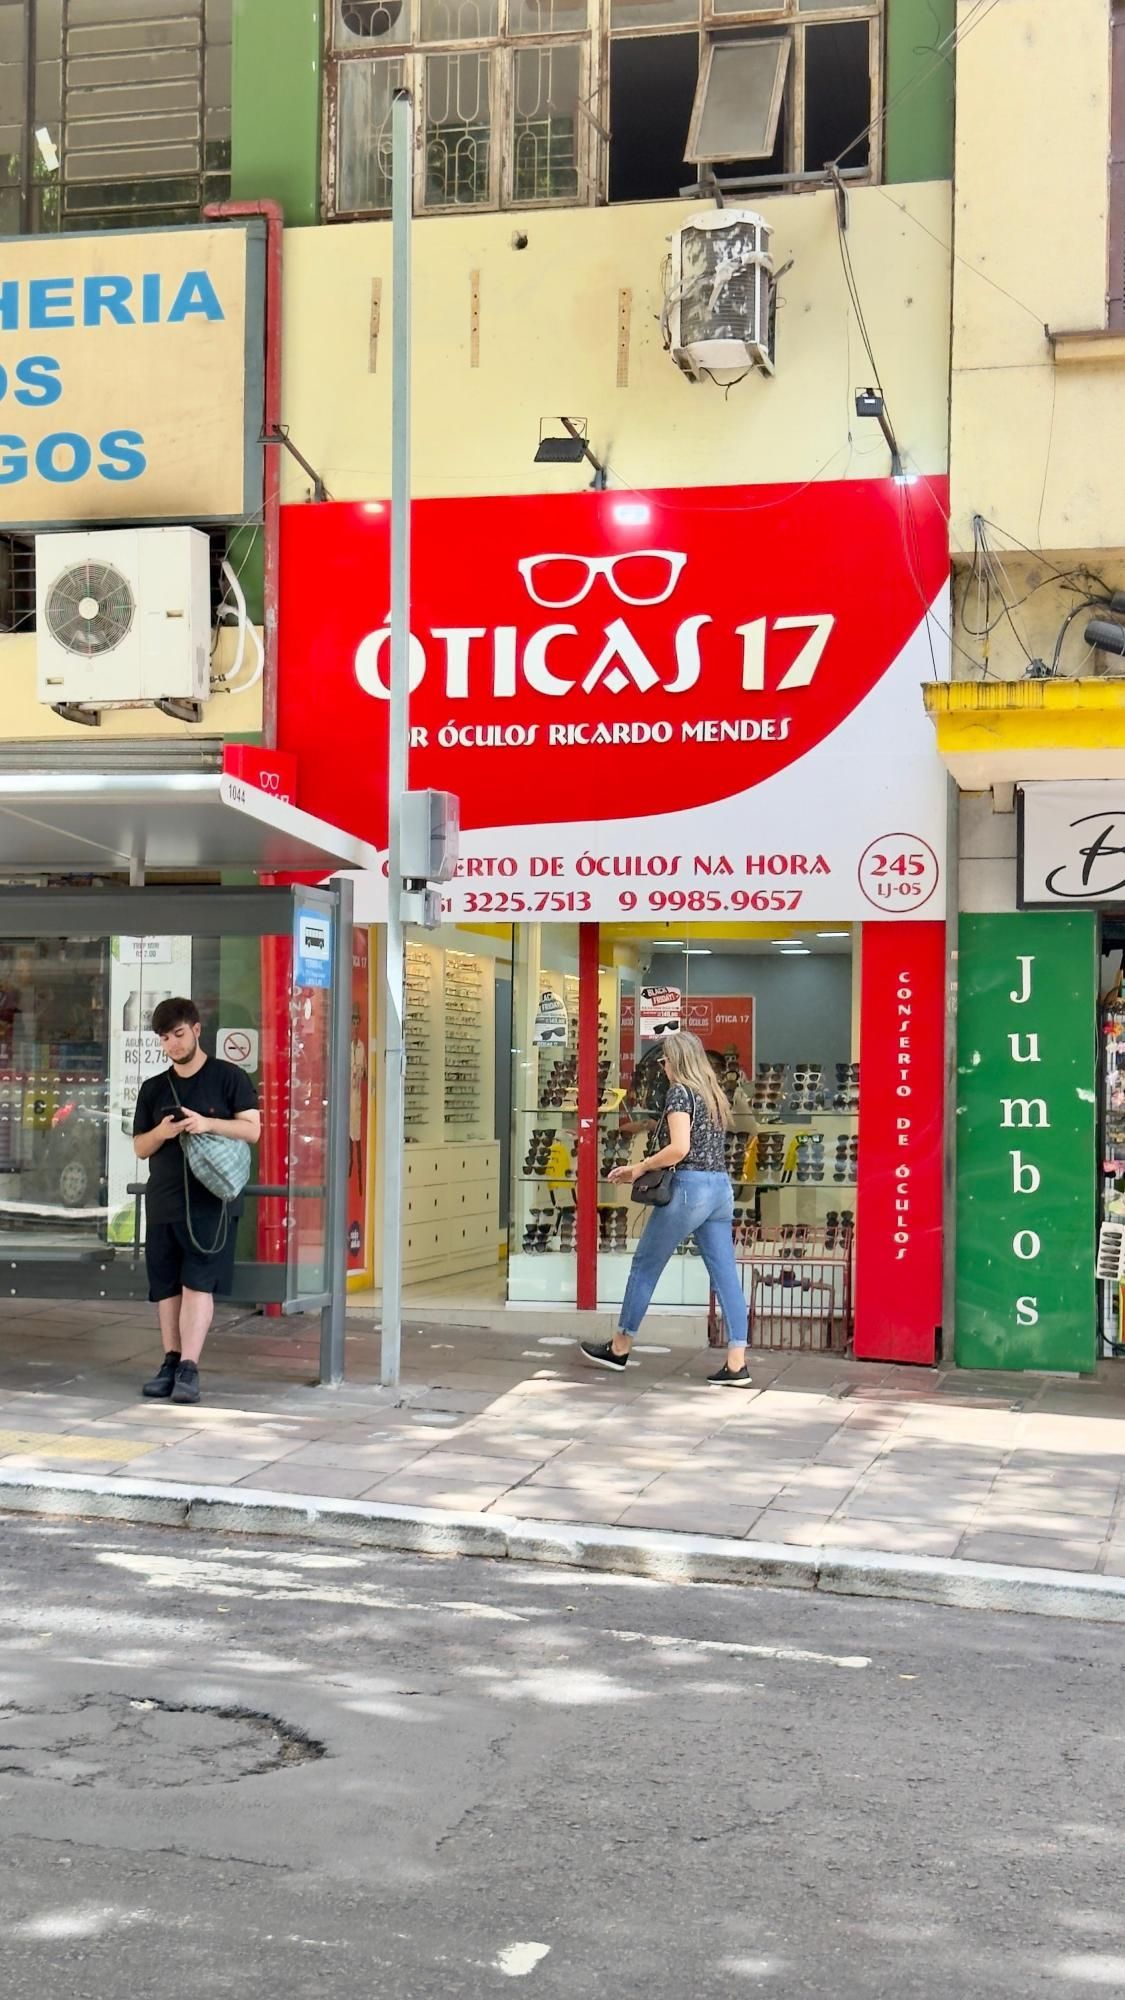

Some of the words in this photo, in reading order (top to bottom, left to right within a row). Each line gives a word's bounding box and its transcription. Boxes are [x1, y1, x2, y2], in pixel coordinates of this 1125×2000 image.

[354, 604, 712, 700] ÓTICAS
[735, 613, 835, 691] 17
[438, 719, 539, 748] ÓCULOS
[549, 721, 673, 746] RICARDO
[681, 717, 791, 743] MENDES
[228, 783, 246, 805] 1044
[530, 856, 563, 877] DE
[575, 852, 681, 878] ÓCULOS
[693, 855, 734, 876] NA
[746, 855, 831, 876] HORA
[870, 854, 925, 877] 245
[463, 891, 591, 913] 3225.7513
[618, 891, 637, 911] 9
[648, 889, 802, 912] 9985.9657
[877, 882, 922, 899] LJ-05
[740, 1015, 749, 1023] 17
[896, 971, 912, 1097] CONSERTO
[896, 1117, 911, 1146] DE
[999, 956, 1051, 1326] Jumbos
[894, 1164, 910, 1261] ÓCULOS
